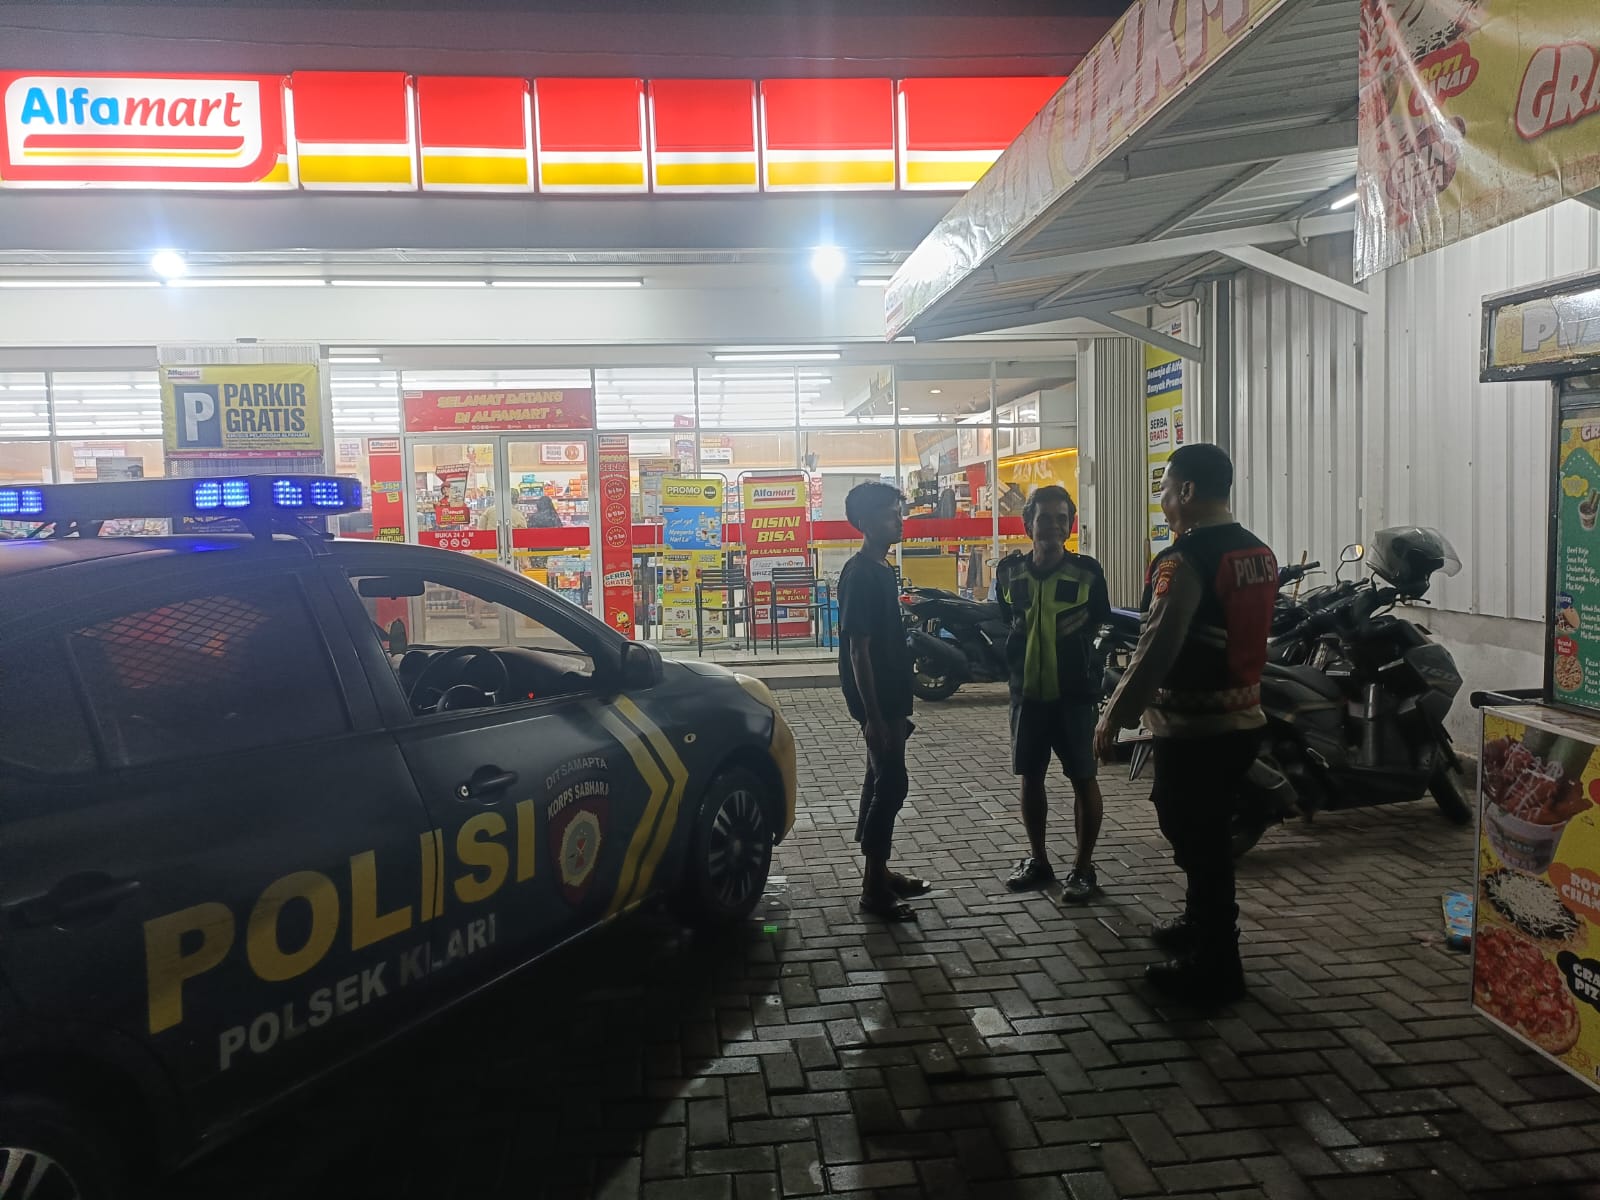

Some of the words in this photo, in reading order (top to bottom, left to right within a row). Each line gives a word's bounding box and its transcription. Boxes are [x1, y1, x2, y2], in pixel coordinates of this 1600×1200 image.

[21, 87, 243, 127] Alfamart
[224, 384, 306, 407] PARKIR
[437, 393, 504, 408] SELAMAT
[184, 393, 214, 441] P
[226, 408, 305, 432] GRATIS
[455, 412, 470, 424] DI
[471, 408, 550, 423] ALFAMART
[1150, 418, 1168, 430] SERBA
[1149, 429, 1169, 441] GRATIS
[667, 486, 701, 495] PROMO
[754, 487, 796, 497] Alfamart
[751, 516, 801, 529] DISINI
[757, 530, 795, 543] BISA
[605, 571, 631, 580] SERBA
[547, 787, 574, 822] KORPS
[143, 800, 535, 1035] POLISI
[219, 961, 388, 1072] POLSEK
[400, 912, 496, 986] KLARI
